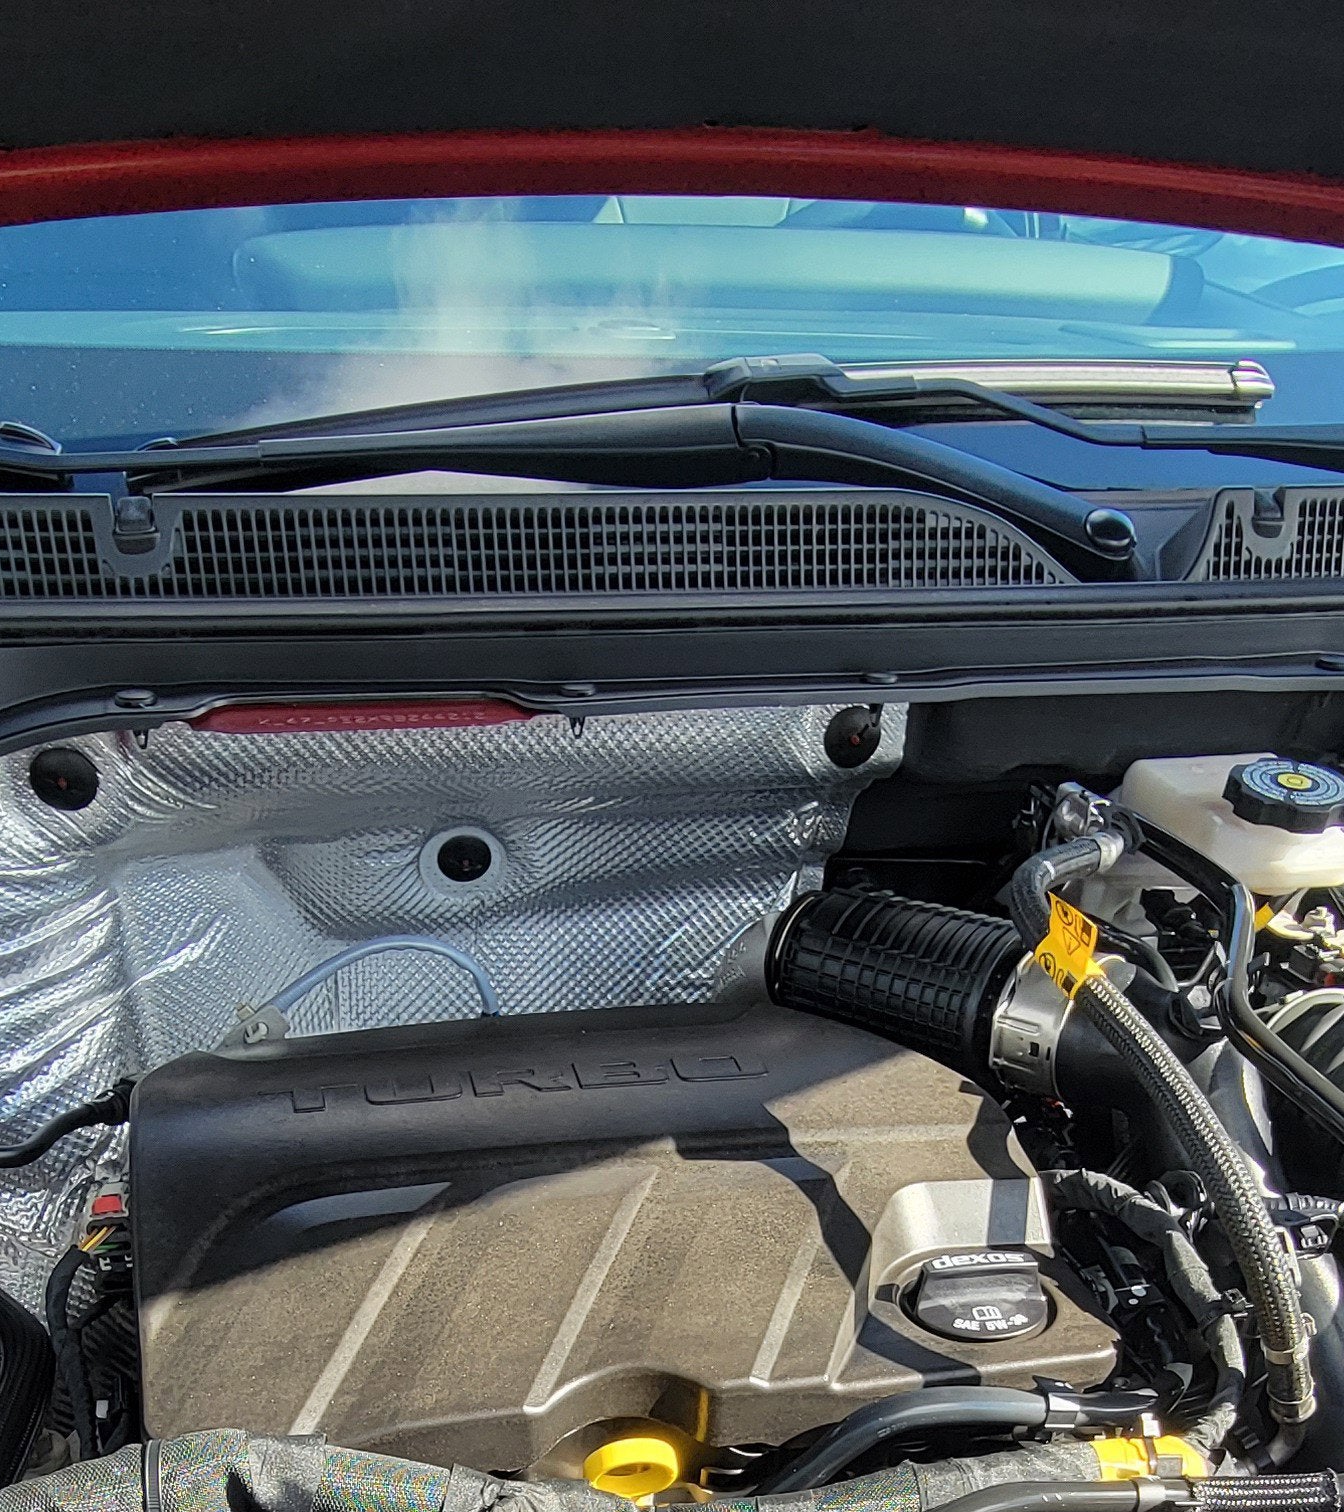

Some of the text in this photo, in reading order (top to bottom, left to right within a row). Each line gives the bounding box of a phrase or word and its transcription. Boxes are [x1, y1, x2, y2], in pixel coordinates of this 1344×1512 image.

[258, 1055, 769, 1113] TURBO
[932, 1253, 1024, 1269] dexos
[953, 1318, 981, 1331] SAE
